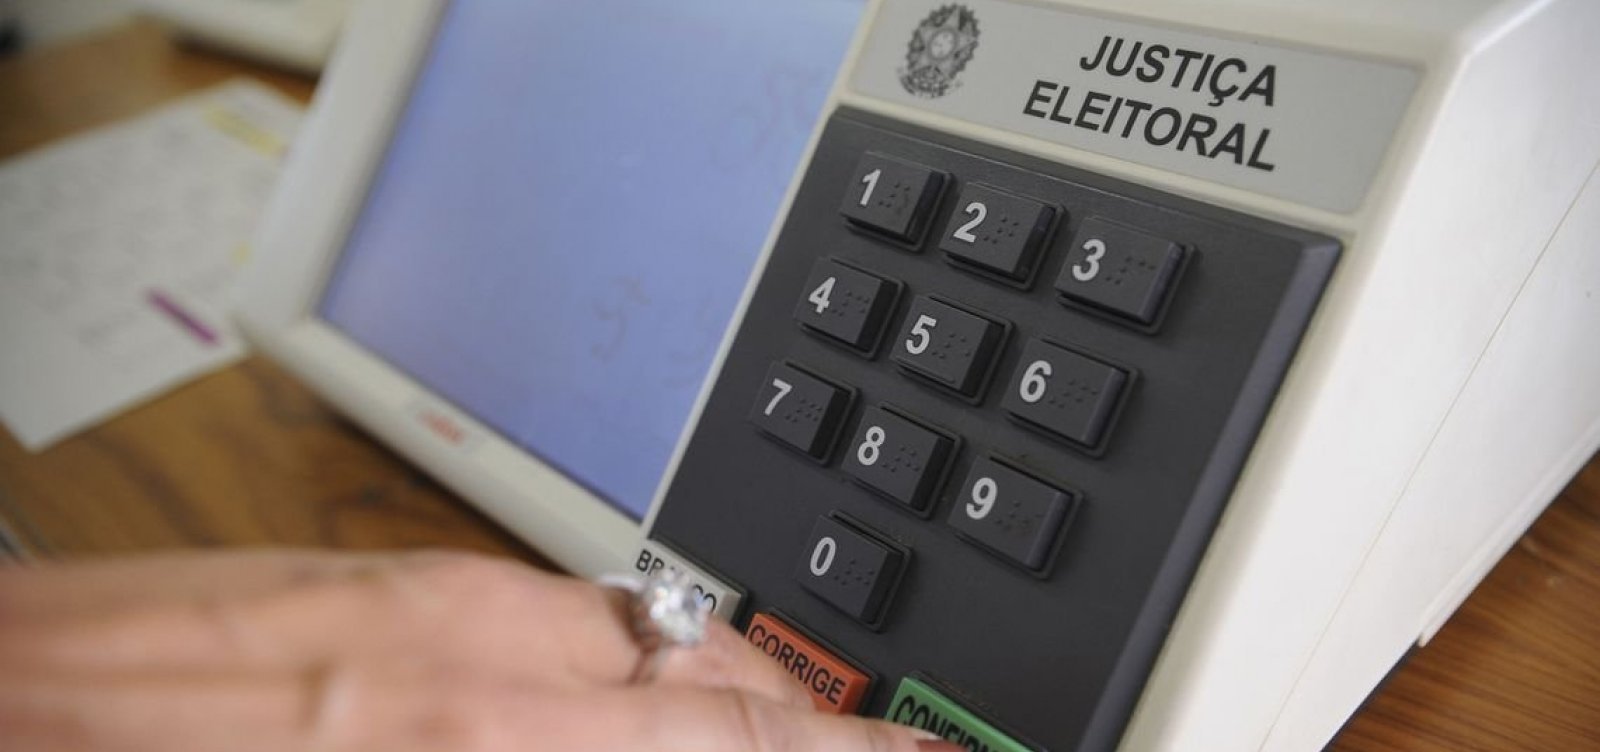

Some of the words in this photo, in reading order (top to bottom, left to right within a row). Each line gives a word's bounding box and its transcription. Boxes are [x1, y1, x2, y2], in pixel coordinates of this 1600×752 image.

[1079, 35, 1277, 107] JUSTIÇA
[1022, 79, 1275, 172] ELEITORAL
[859, 168, 882, 206] 1
[952, 201, 988, 243] 2
[1071, 238, 1107, 282] 3
[807, 276, 837, 314] 4
[904, 314, 937, 355] 5
[763, 378, 793, 416] 7
[1019, 360, 1053, 403] 6
[856, 425, 886, 466] 8
[965, 477, 999, 520] 9
[809, 536, 837, 577] 0
[748, 624, 847, 705] CORRIGE
